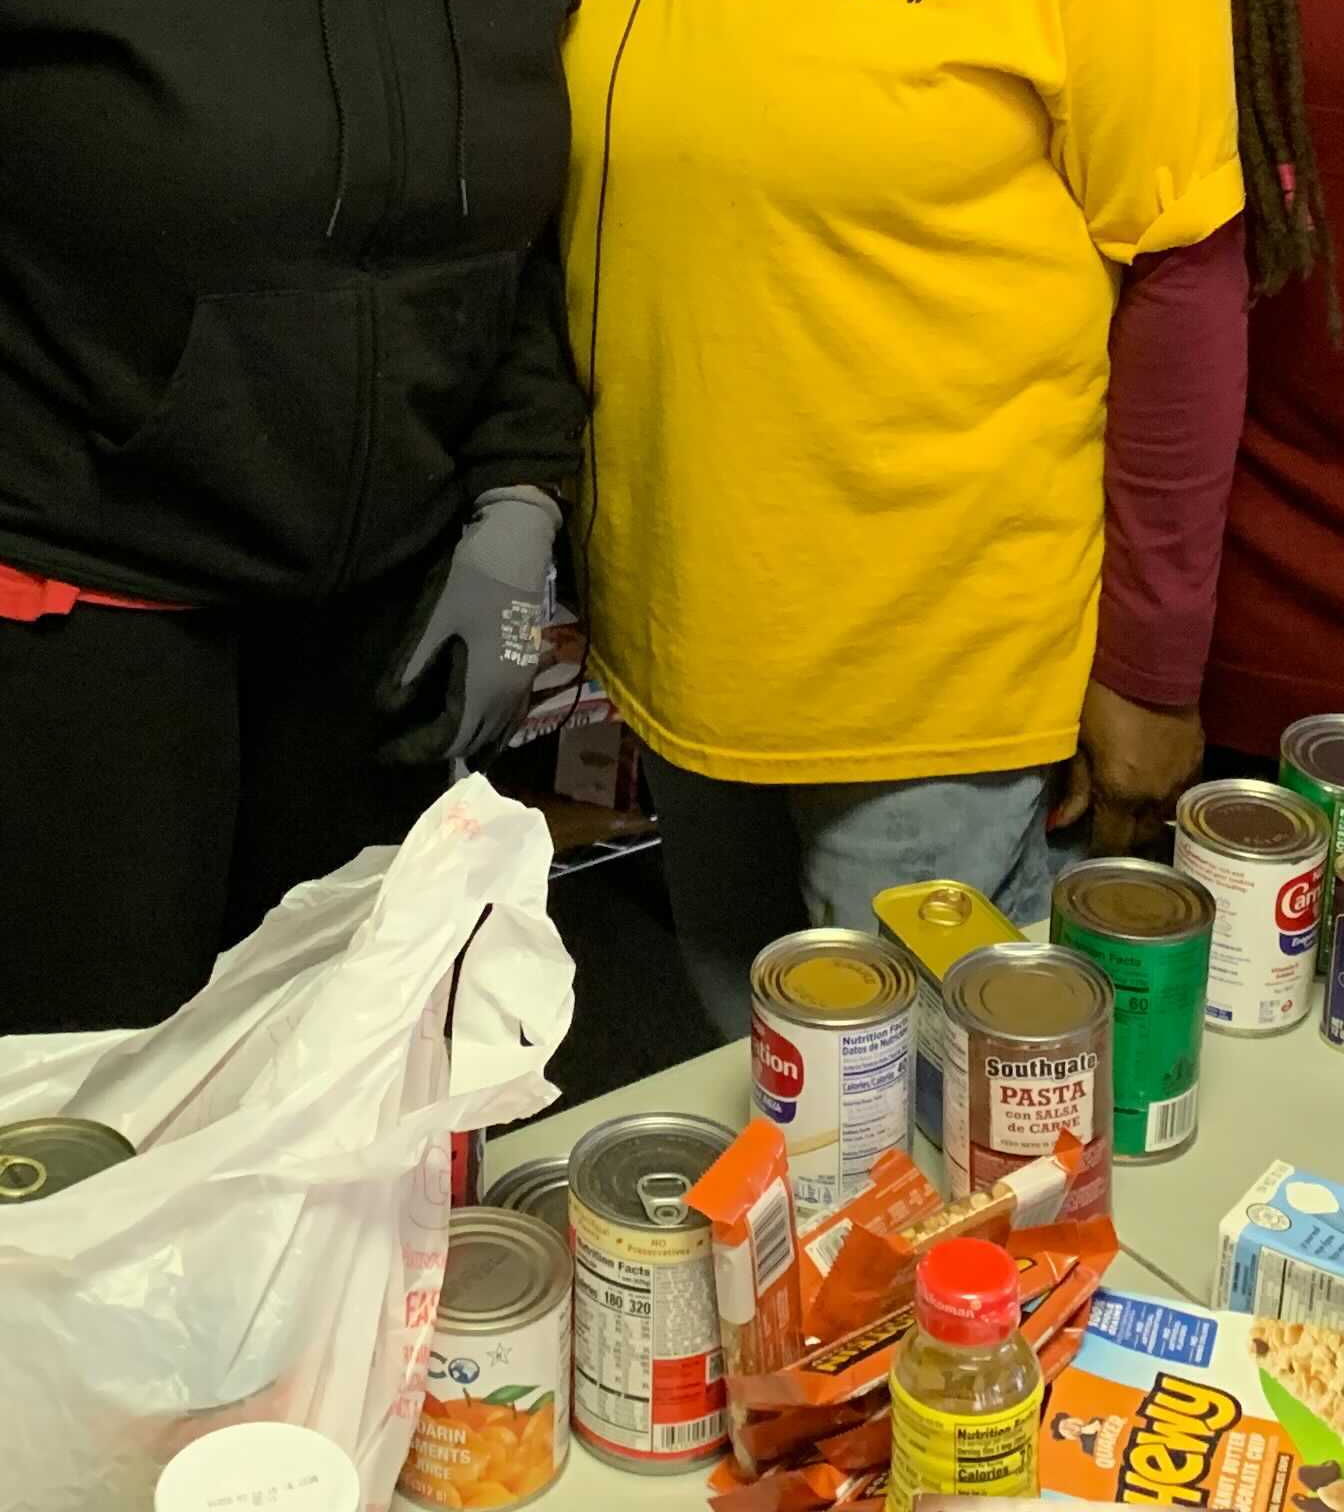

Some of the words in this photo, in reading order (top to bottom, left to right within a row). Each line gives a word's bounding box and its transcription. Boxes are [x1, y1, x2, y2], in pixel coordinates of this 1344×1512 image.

[1128, 997, 1149, 1011] 60
[842, 1029, 888, 1046] Nutrition
[842, 1043, 867, 1057] Datos
[869, 1041, 878, 1052] de
[986, 1052, 1097, 1080] Southgate
[999, 1080, 1087, 1107] PASTA
[1005, 1110, 1032, 1121] con
[1035, 1103, 1079, 1121] SALSA
[1007, 1122, 1025, 1133] de
[1030, 1115, 1081, 1134] CARNE
[627, 1243, 690, 1257] Preservatives
[618, 1259, 651, 1276] Facts
[604, 1291, 623, 1309] 180
[629, 1299, 651, 1315] 320
[957, 1424, 1011, 1441] Nutrition
[1094, 1414, 1128, 1469] QUAKER
[957, 1465, 1009, 1483] Calories
